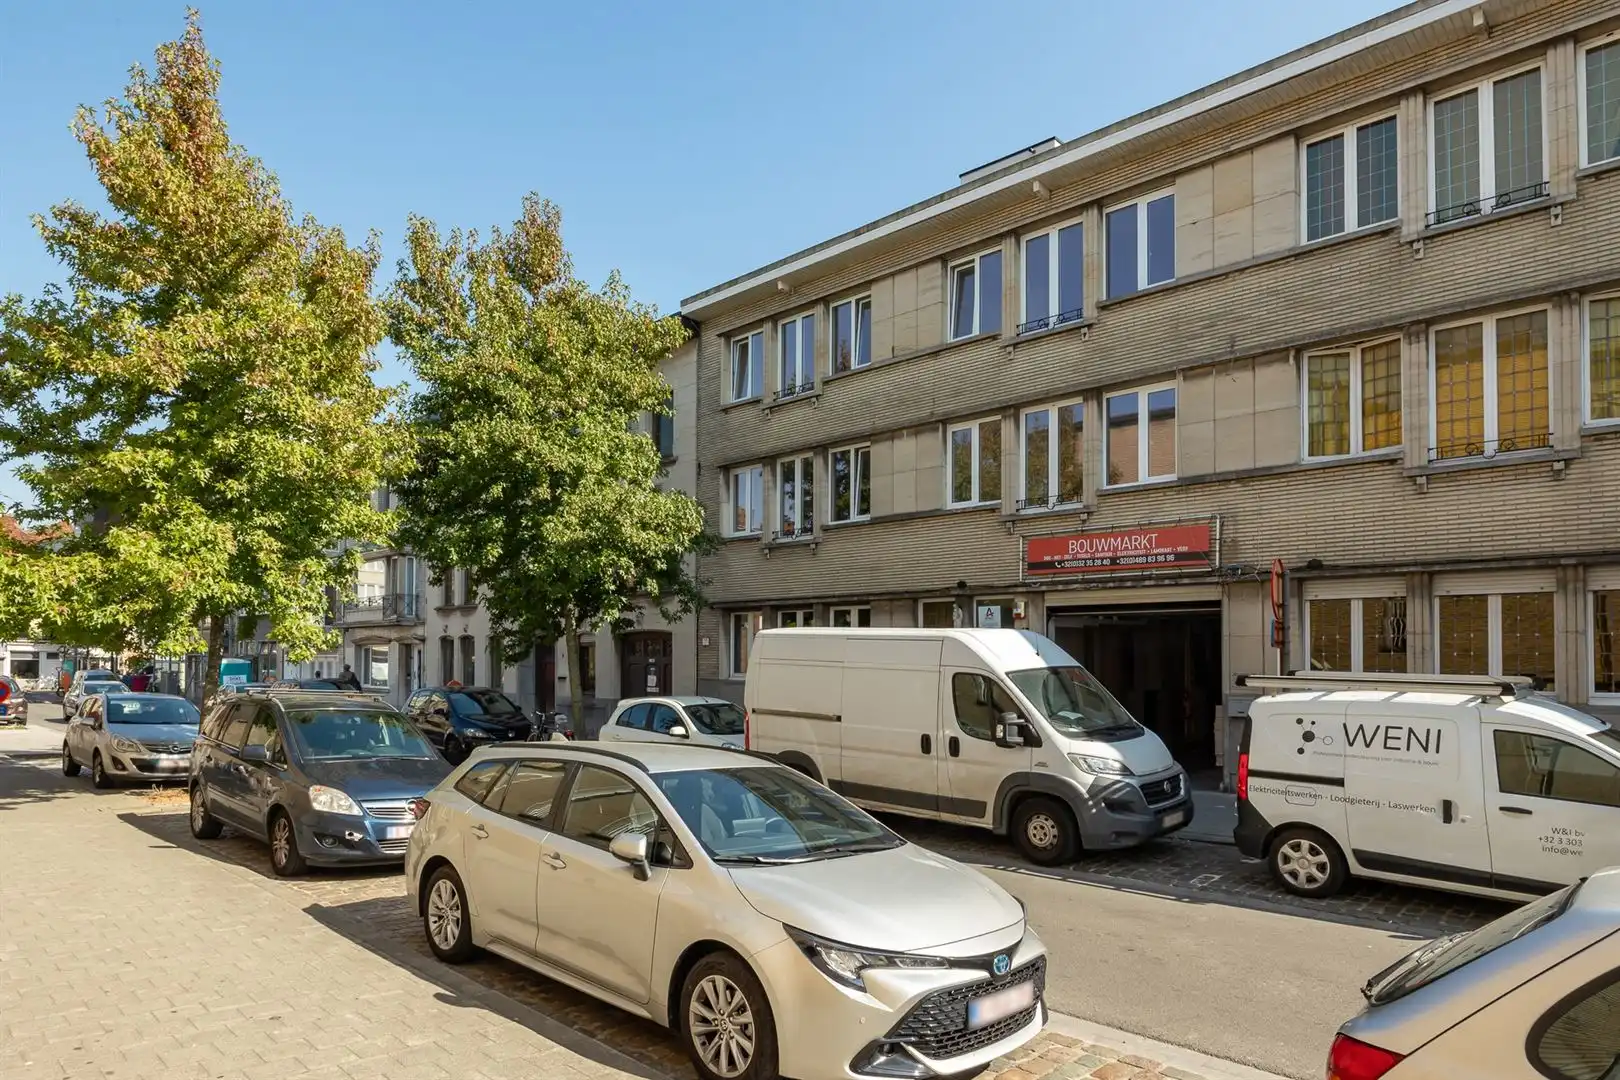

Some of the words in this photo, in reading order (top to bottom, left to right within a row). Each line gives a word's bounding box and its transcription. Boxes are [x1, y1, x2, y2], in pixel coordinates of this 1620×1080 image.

[1068, 533, 1159, 554] BOUWMARKT
[1342, 722, 1442, 754] WENI
[1248, 784, 1323, 800] Elektriciteitswerken
[1330, 794, 1381, 809] Loodgieterij
[1388, 800, 1437, 813] Laswerken
[1536, 835, 1555, 844] +32
[1557, 837, 1563, 845] 3
[1565, 838, 1583, 847] 303
[1551, 827, 1572, 836] W&I
